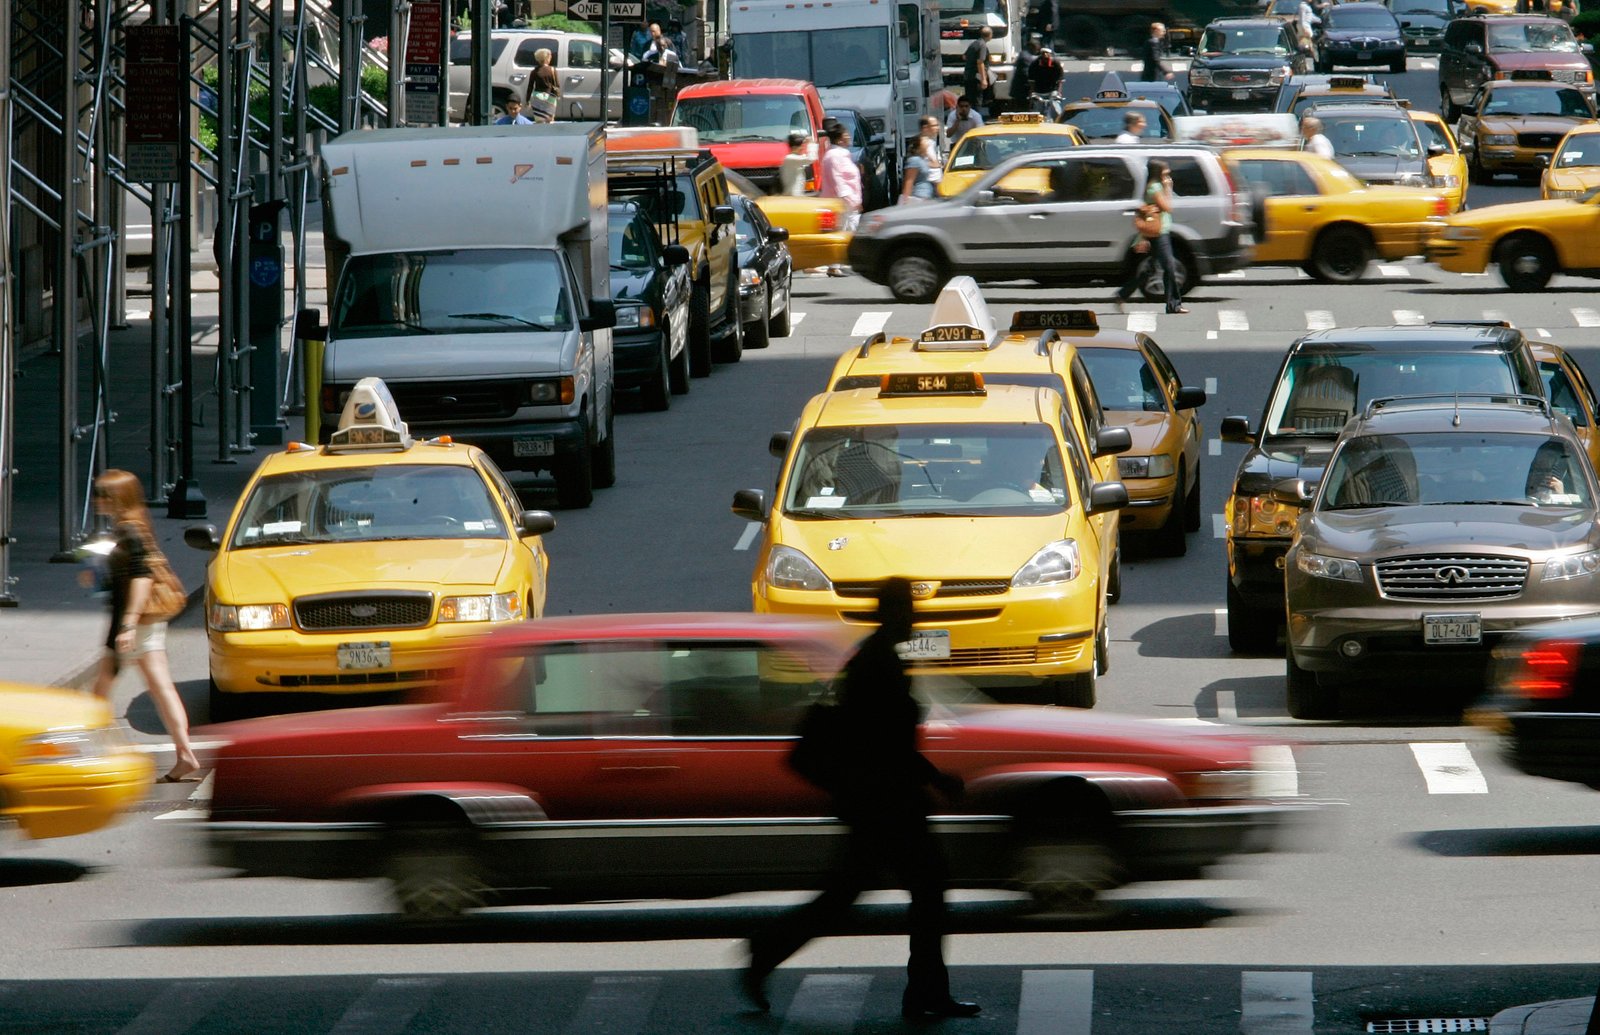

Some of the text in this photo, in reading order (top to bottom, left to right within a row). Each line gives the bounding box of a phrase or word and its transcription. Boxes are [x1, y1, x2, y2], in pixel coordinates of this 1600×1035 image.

[578, 4, 636, 14] ONE WAY
[636, 73, 645, 85] P
[259, 222, 273, 240] P
[1040, 314, 1069, 326] 6K33
[937, 327, 966, 341] 2V91
[917, 376, 947, 391] 5E44
[352, 430, 383, 443] 9N36
